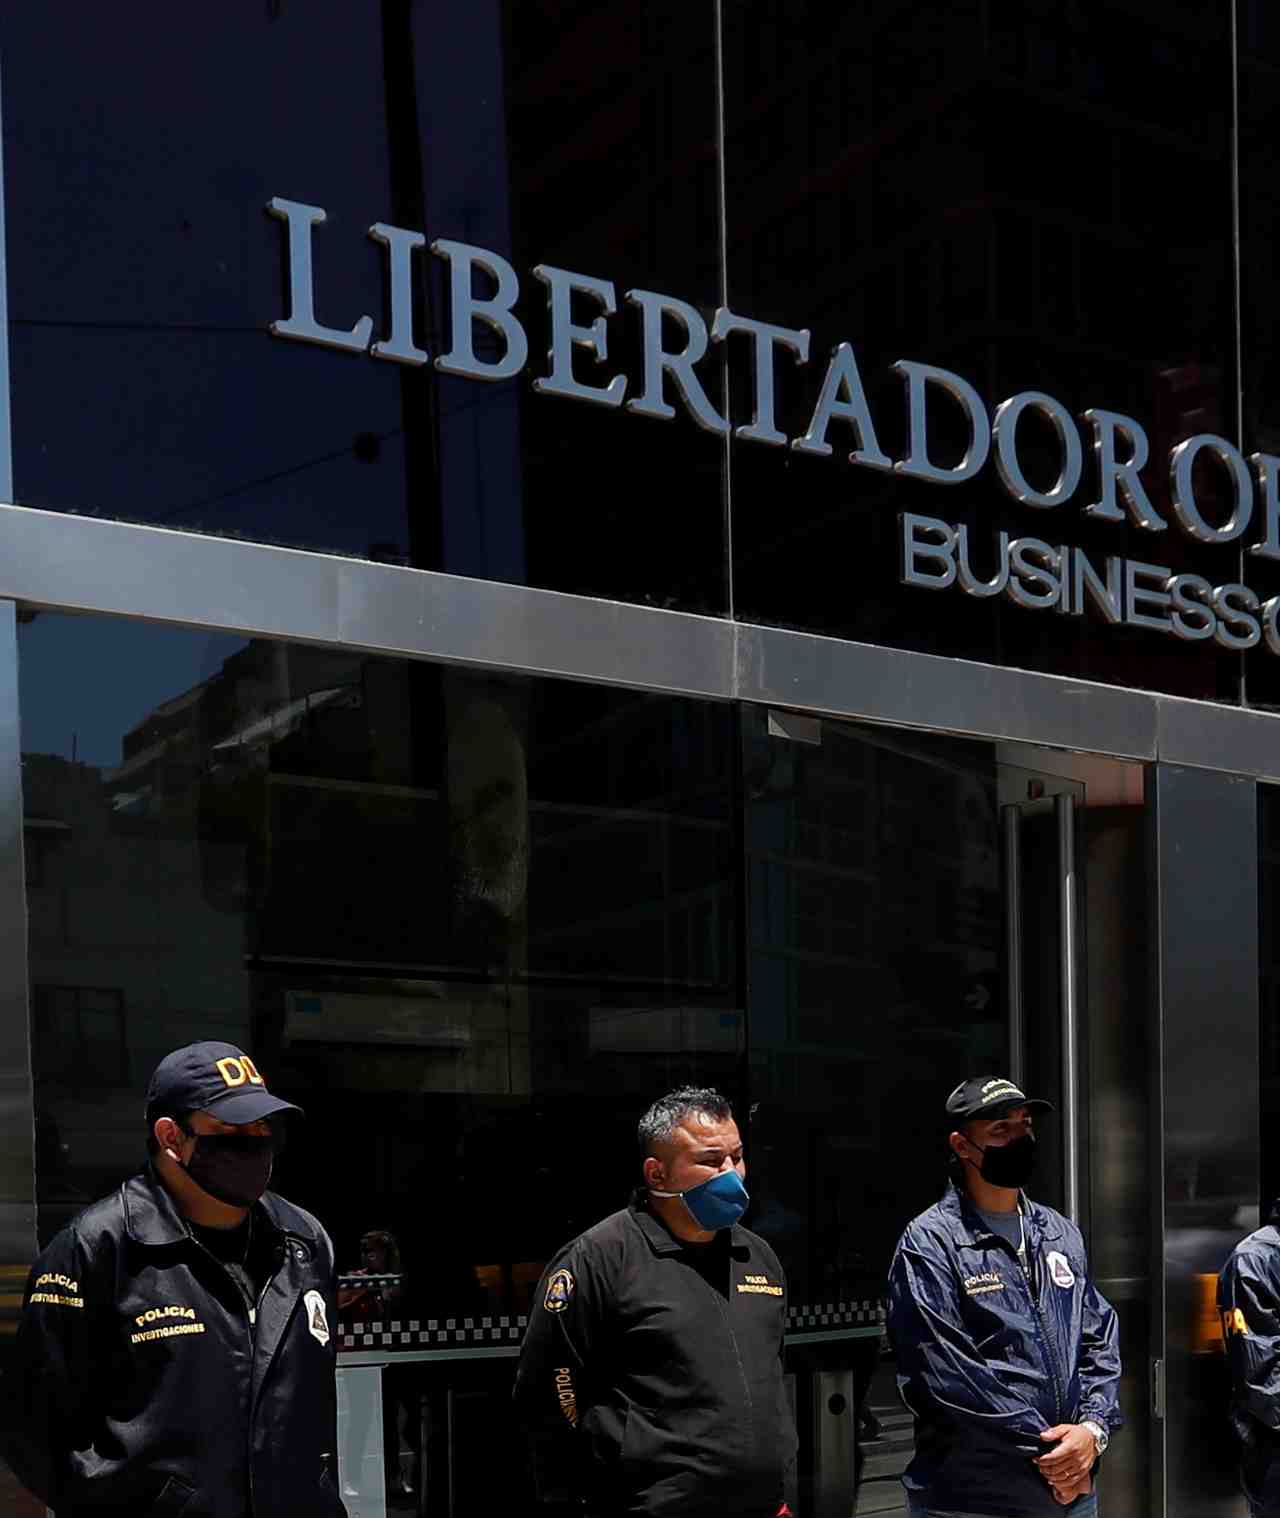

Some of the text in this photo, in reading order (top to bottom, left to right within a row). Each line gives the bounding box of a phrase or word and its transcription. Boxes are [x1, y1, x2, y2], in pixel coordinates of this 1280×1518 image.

[269, 196, 1168, 532] LIBERTADOR
[900, 511, 1261, 649] BUSINESS
[35, 1272, 79, 1293] POLICIA
[135, 1304, 196, 1327] POLICIA
[131, 1322, 206, 1344] INVESTIGACIONES
